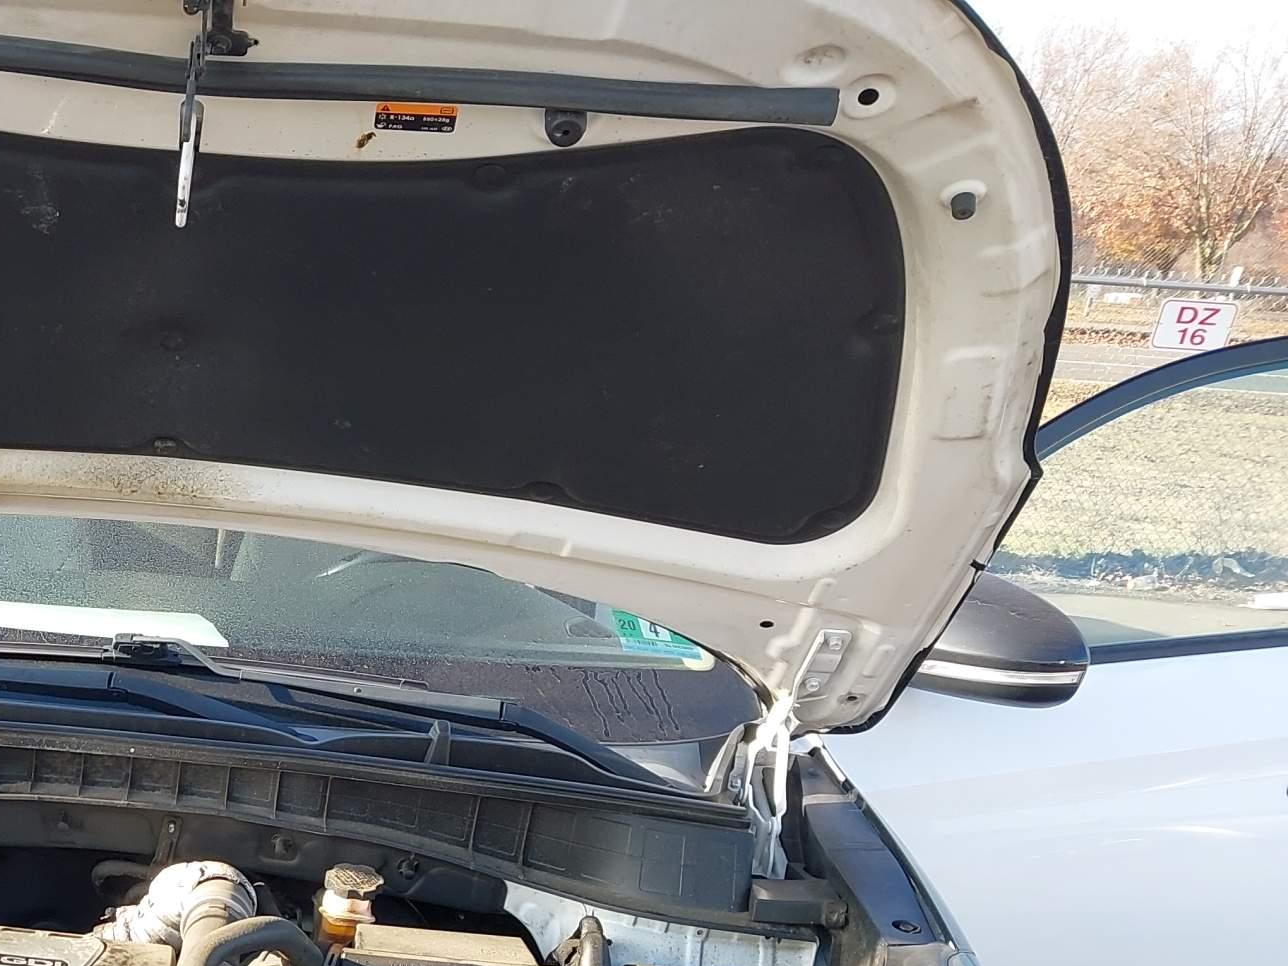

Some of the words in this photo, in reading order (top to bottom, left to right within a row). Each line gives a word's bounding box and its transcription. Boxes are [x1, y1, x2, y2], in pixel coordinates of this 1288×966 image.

[1176, 306, 1221, 326] DZ
[1178, 327, 1207, 346] 16
[618, 618, 636, 631] 20
[648, 622, 660, 638] 4
